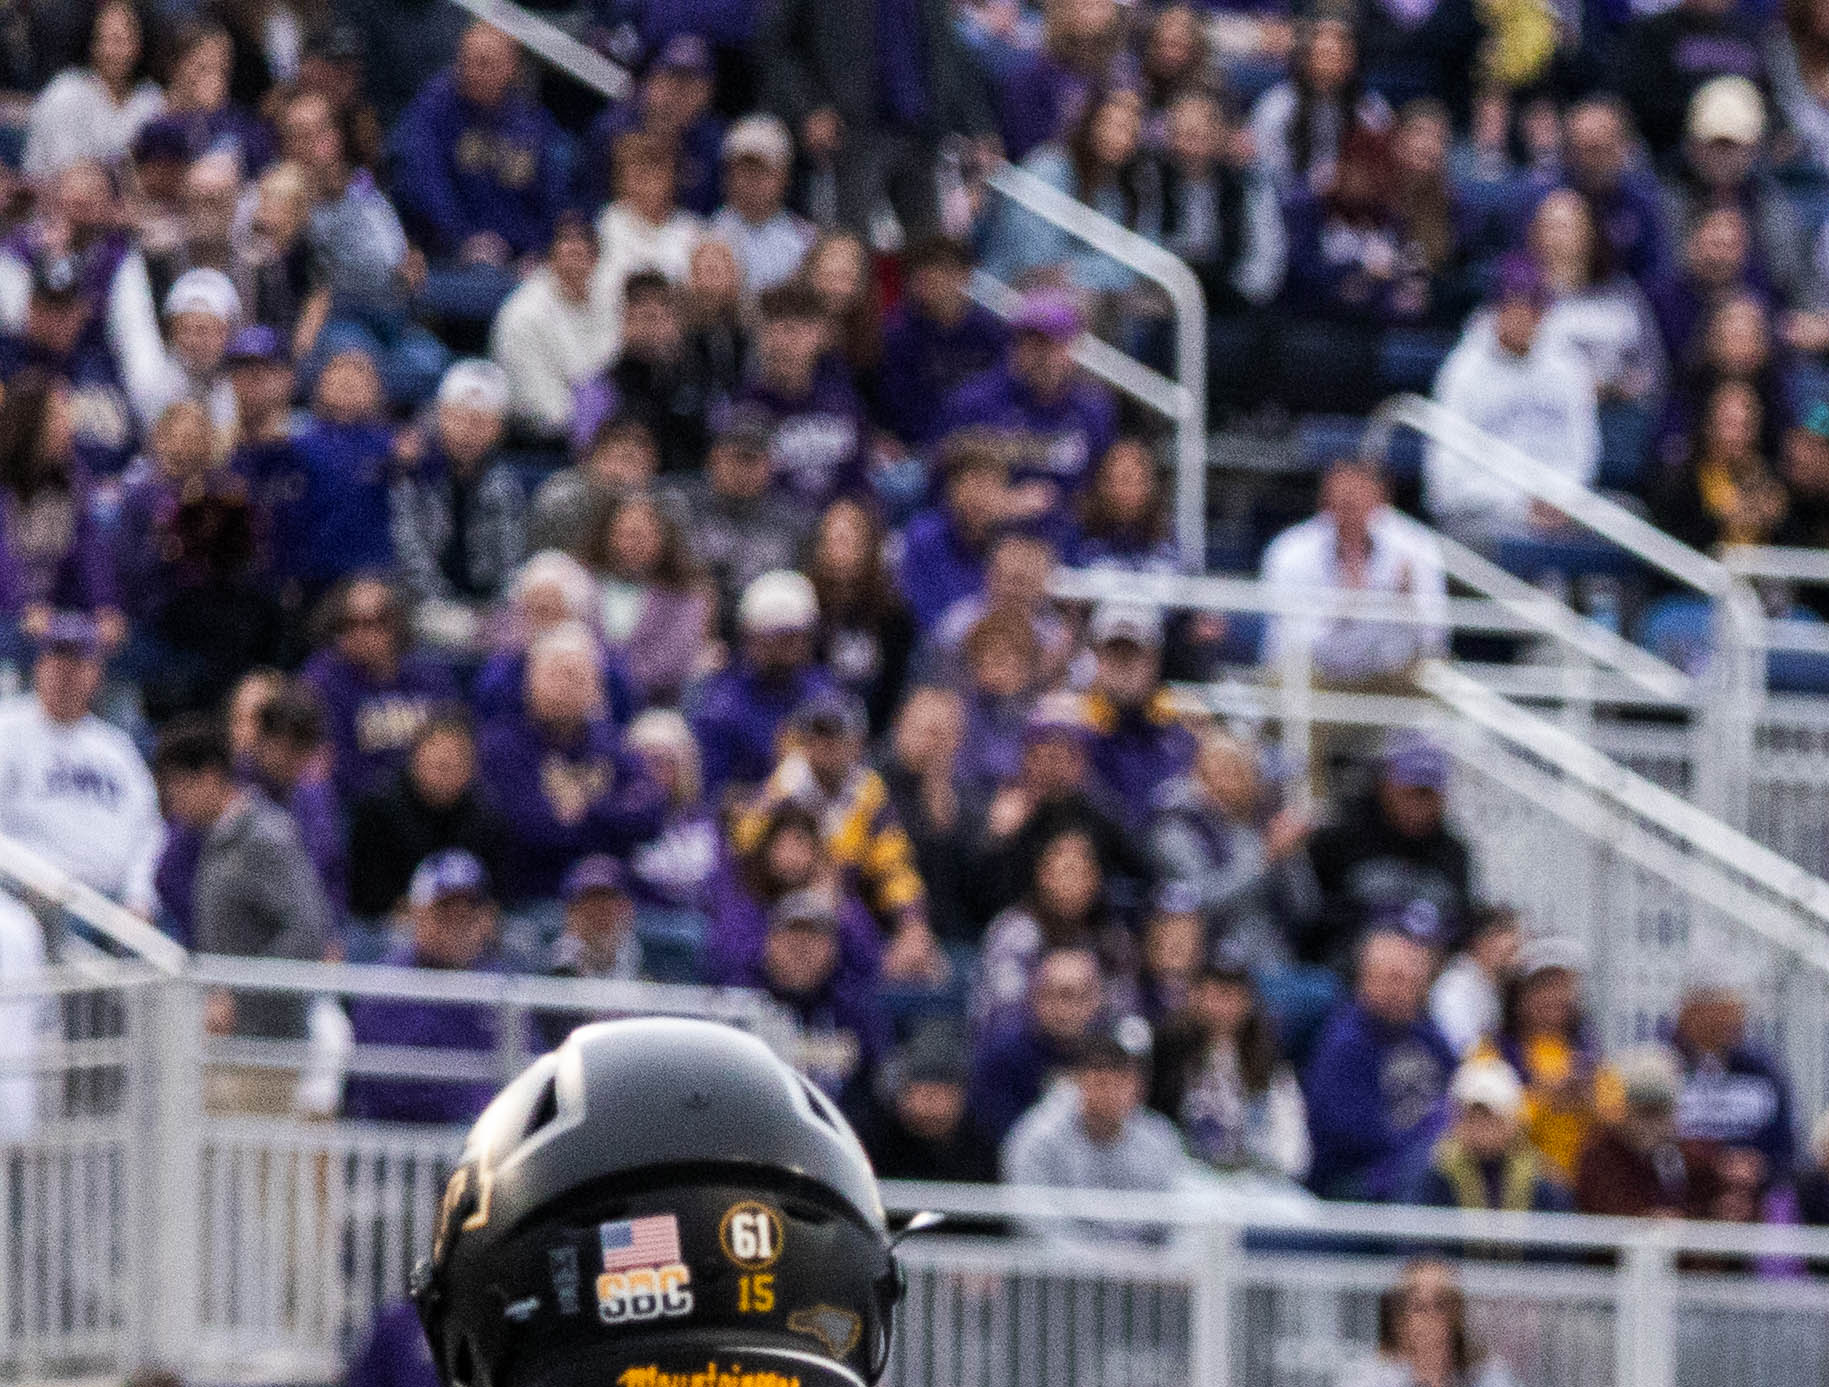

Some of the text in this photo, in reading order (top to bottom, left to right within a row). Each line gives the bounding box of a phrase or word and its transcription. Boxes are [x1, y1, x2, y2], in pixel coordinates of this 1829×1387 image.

[730, 1212, 773, 1259] 61
[596, 1263, 694, 1325] SBC
[738, 1273, 776, 1313] 15
